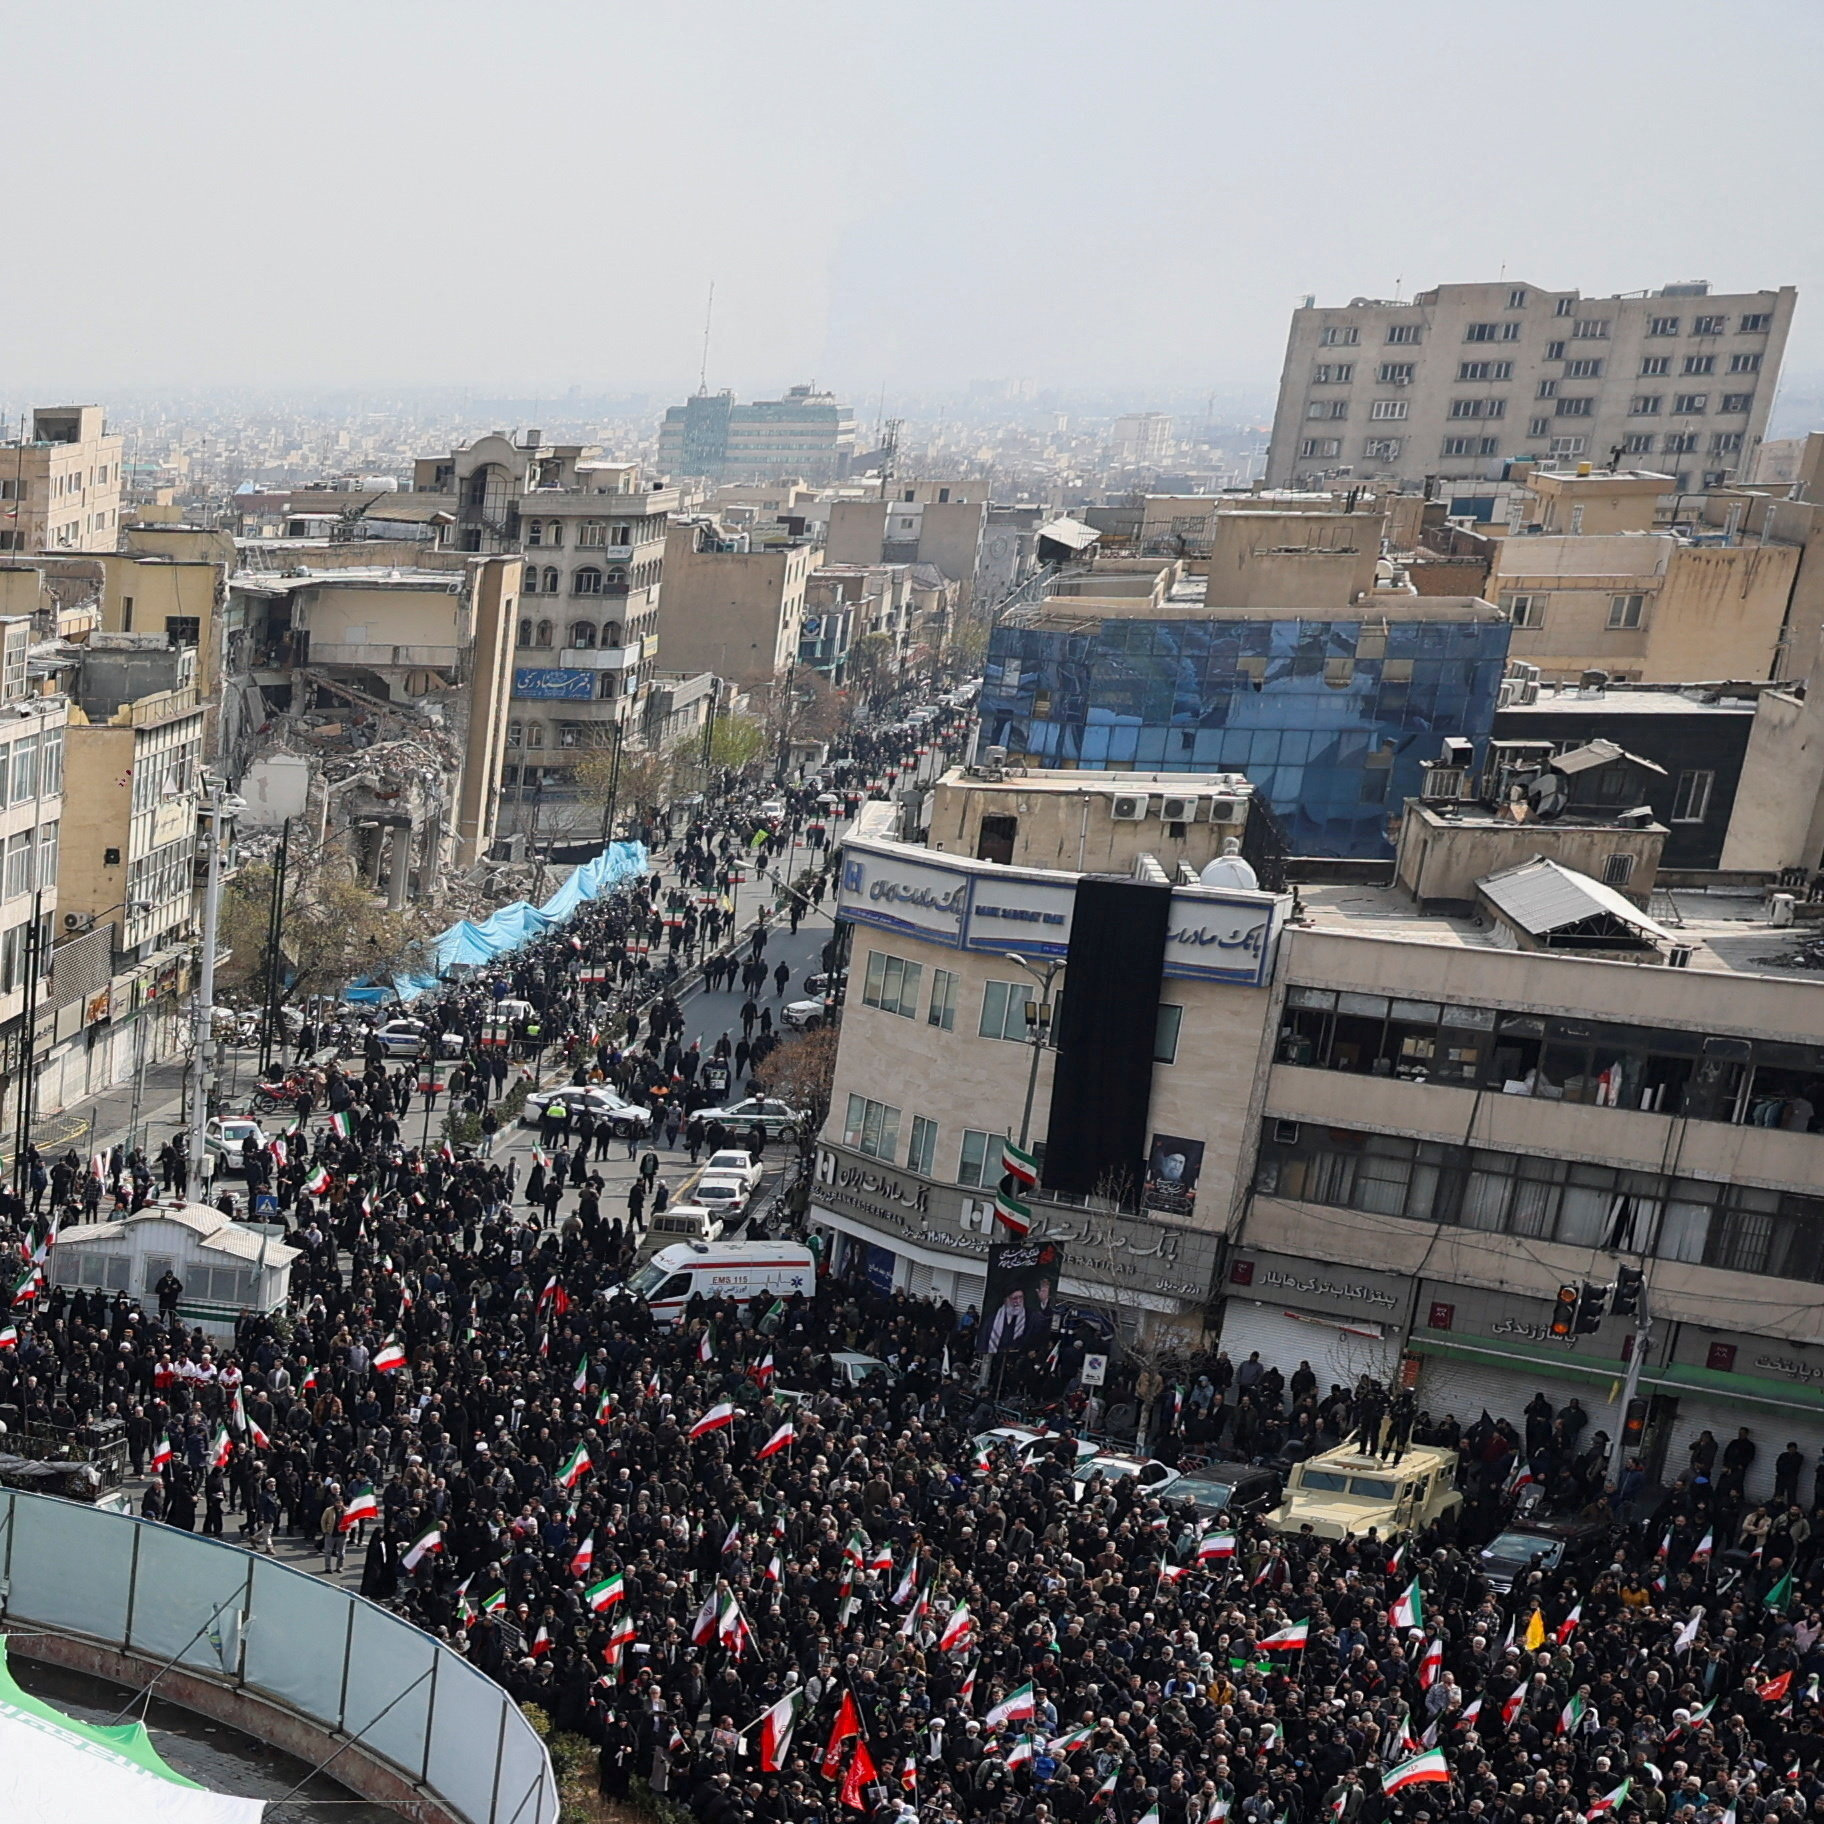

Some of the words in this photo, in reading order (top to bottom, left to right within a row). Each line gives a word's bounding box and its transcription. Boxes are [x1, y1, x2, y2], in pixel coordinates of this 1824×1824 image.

[1218, 923, 1266, 958] بانک
[1128, 1228, 1181, 1268] بانک
[712, 1276, 730, 1284] EMS
[1297, 1279, 1332, 1294] ترکی
[1363, 1289, 1398, 1310] پیتزا
